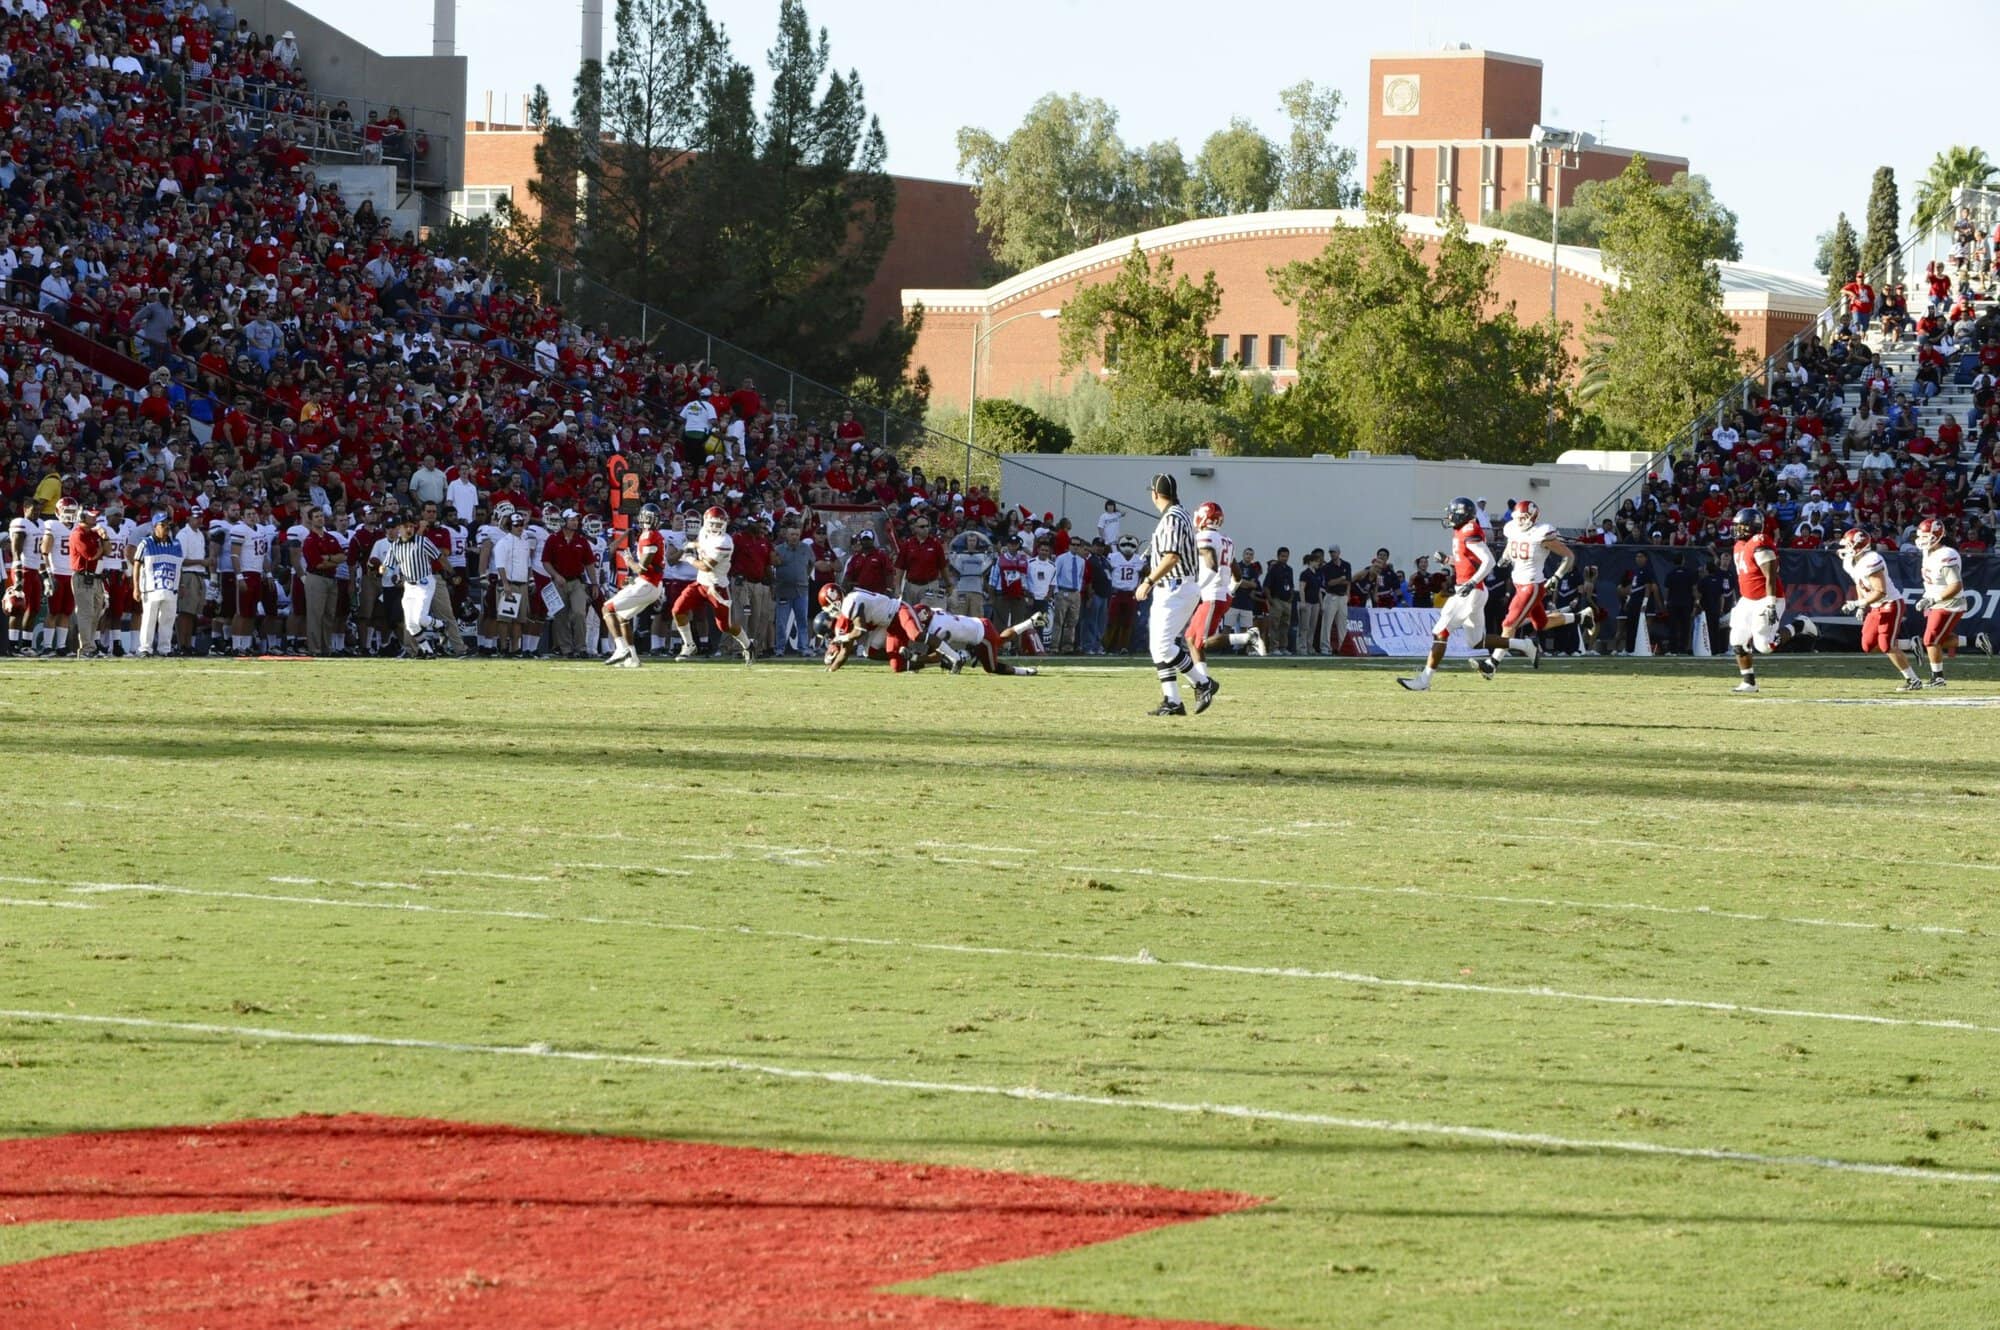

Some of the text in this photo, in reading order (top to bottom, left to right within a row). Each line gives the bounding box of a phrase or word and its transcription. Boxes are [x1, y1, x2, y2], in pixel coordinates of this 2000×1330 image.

[622, 472, 640, 499] 2
[60, 539, 70, 555] 5
[455, 540, 464, 555] 5
[1120, 567, 1134, 581] 12
